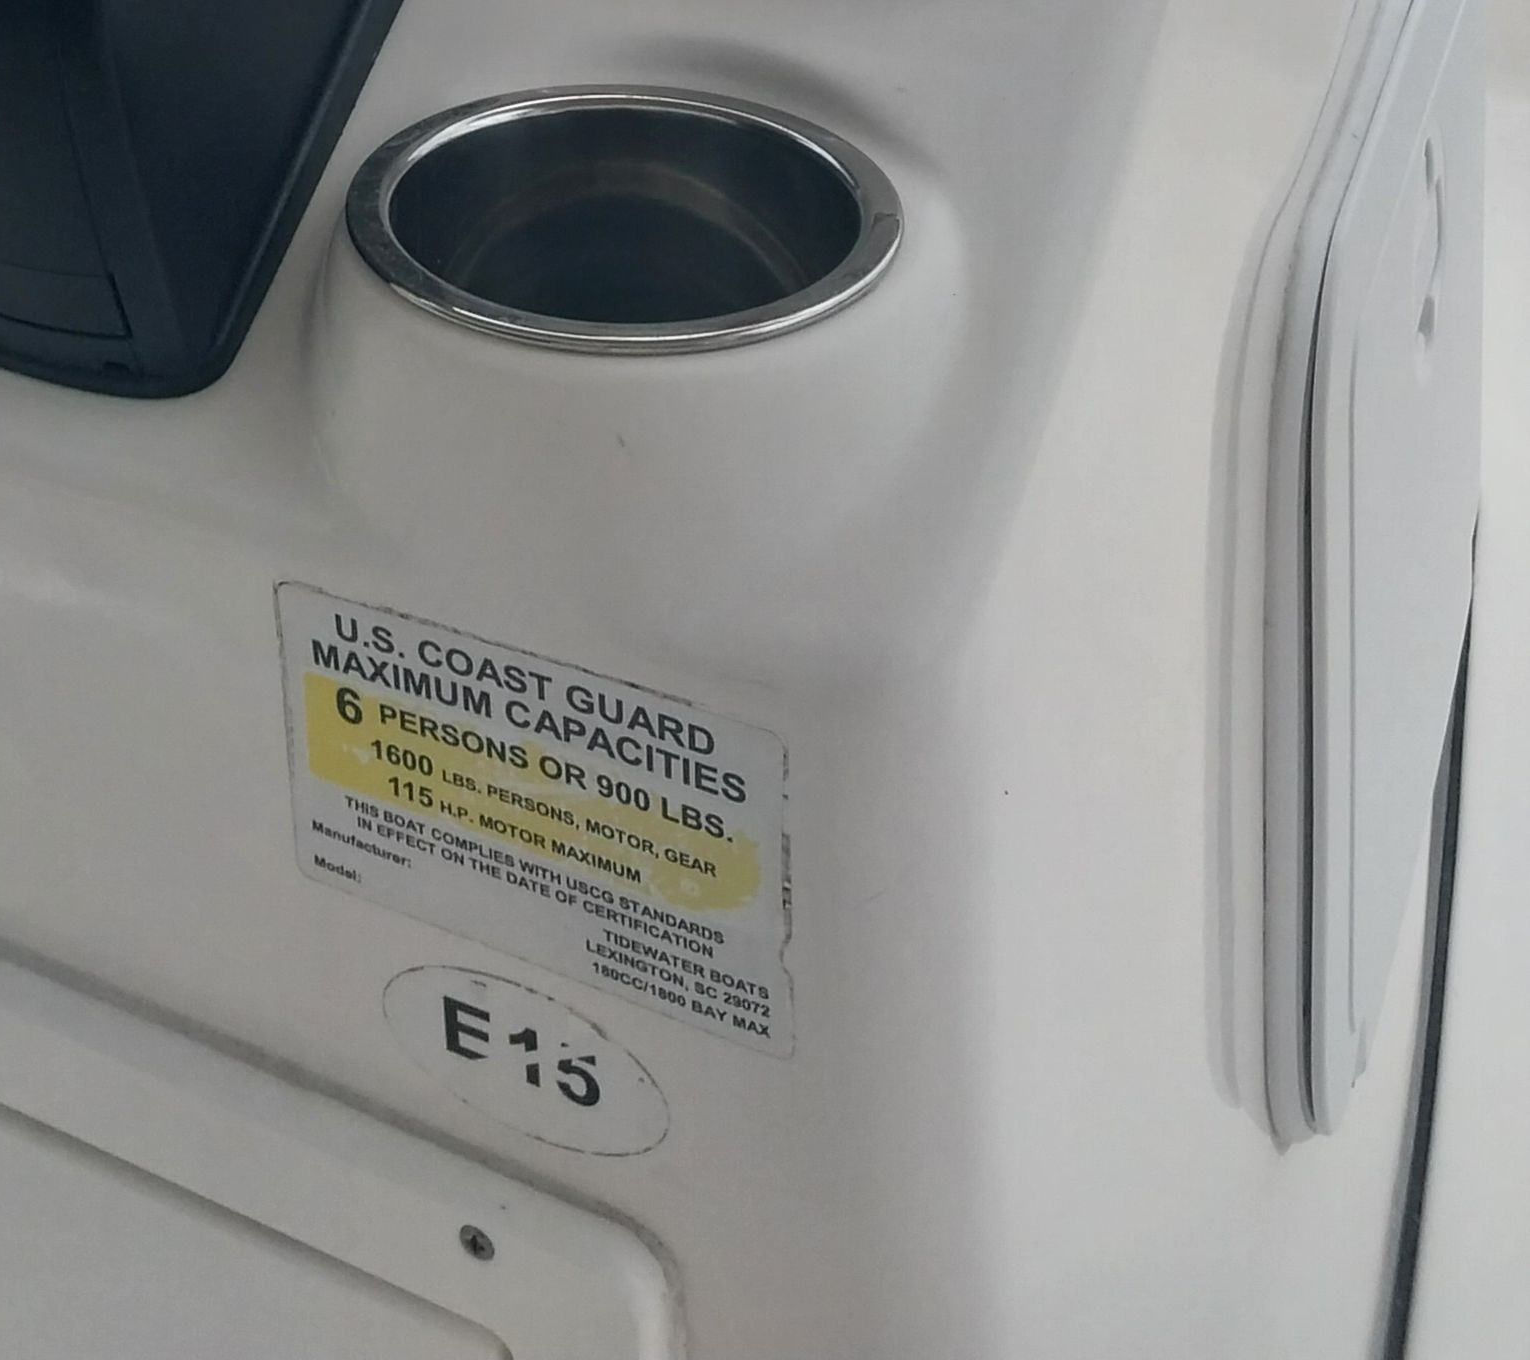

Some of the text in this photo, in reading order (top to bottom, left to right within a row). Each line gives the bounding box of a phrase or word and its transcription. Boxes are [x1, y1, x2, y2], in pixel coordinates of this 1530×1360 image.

[311, 639, 747, 803] MAXIMUM CAPACITIES
[335, 613, 715, 756] U.S. COAST GUARD
[336, 686, 734, 843] 6 PERSONS OR 900 LBS.
[371, 739, 718, 878] 1600 LBS. PERSONS, MOTOR, GEAR
[312, 819, 412, 869] Manufacturer:
[314, 854, 362, 884] Model:
[345, 795, 725, 945] THIS BOAT COMPLIES WITH USCG STANDARDS
[356, 816, 714, 958] IN EFFECT ON THE DATE OF CERTIFICATION
[388, 777, 641, 883] 115 H.P. MOTOR MAXIMUM
[585, 939, 690, 992] LEXINGTON,
[694, 981, 718, 1000] SC
[592, 962, 771, 1039] 180CC/1800 BAY MAX
[602, 928, 770, 1000] TIDEWATER BOATS
